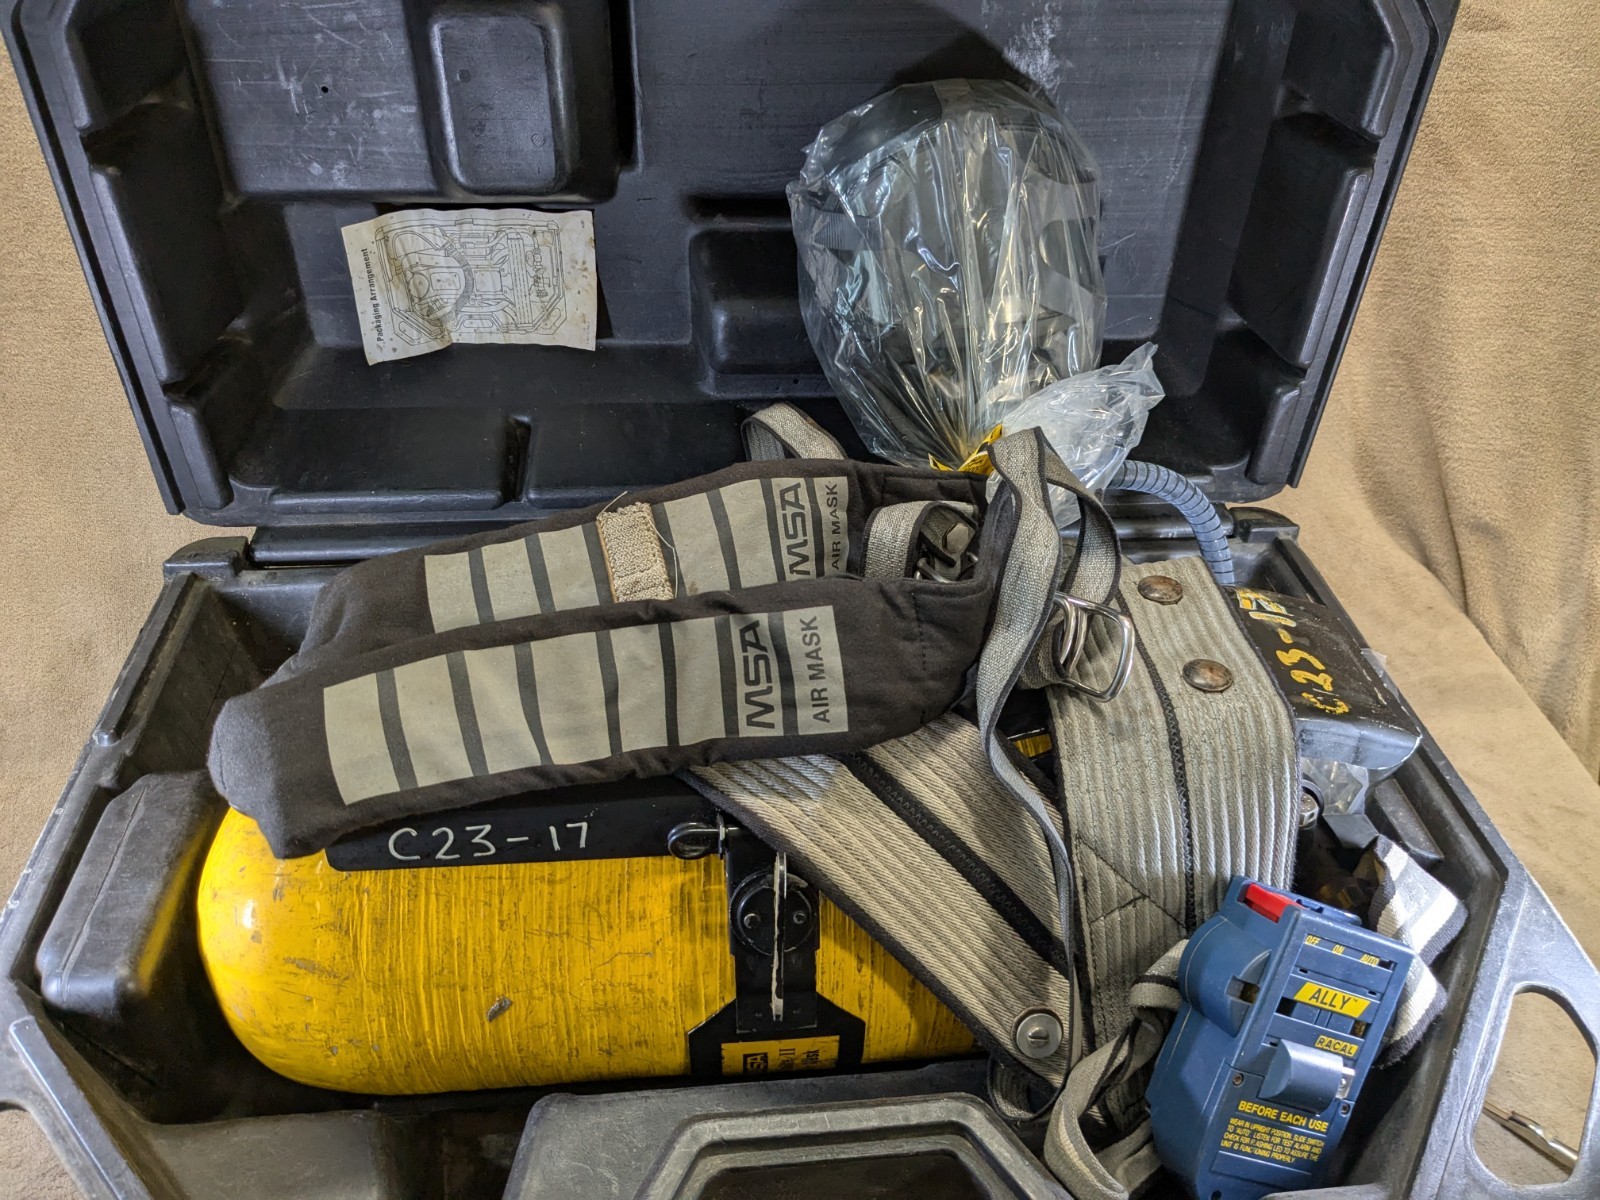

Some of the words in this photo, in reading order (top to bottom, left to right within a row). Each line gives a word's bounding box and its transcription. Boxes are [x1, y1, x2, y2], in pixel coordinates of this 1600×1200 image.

[361, 248, 377, 301] Arrangement
[372, 303, 384, 342] Packaging
[825, 483, 841, 535] MASK
[779, 482, 810, 576] MSA
[830, 541, 842, 570] AIR
[800, 615, 827, 682] MASK
[739, 619, 775, 729] MSA
[810, 687, 830, 723] AIR
[1304, 935, 1321, 946] OFF
[1332, 944, 1345, 955] ON
[1317, 1037, 1354, 1055] RACAL
[1229, 1117, 1244, 1127] WEAR
[1250, 1122, 1272, 1133] UPRIGHT
[1293, 1134, 1307, 1143] SLIDE
[1307, 1138, 1325, 1147] SWITCH
[1238, 1100, 1279, 1120] BEFORE
[1279, 1111, 1307, 1126] EACH
[1308, 1119, 1329, 1132] USE
[1220, 1140, 1233, 1149] UNIT
[1223, 1131, 1240, 1141] CHECK
[1240, 1136, 1251, 1144] FOR
[1273, 1144, 1283, 1153] LED
[1290, 1149, 1309, 1159] ASSURE
[1227, 1124, 1234, 1132] TO
[1253, 1131, 1271, 1141] LISTEN
[1271, 1136, 1281, 1144] FOR
[1282, 1139, 1294, 1147] TEST
[1293, 1142, 1312, 1152] ALARM
[1311, 1146, 1322, 1154] AND
